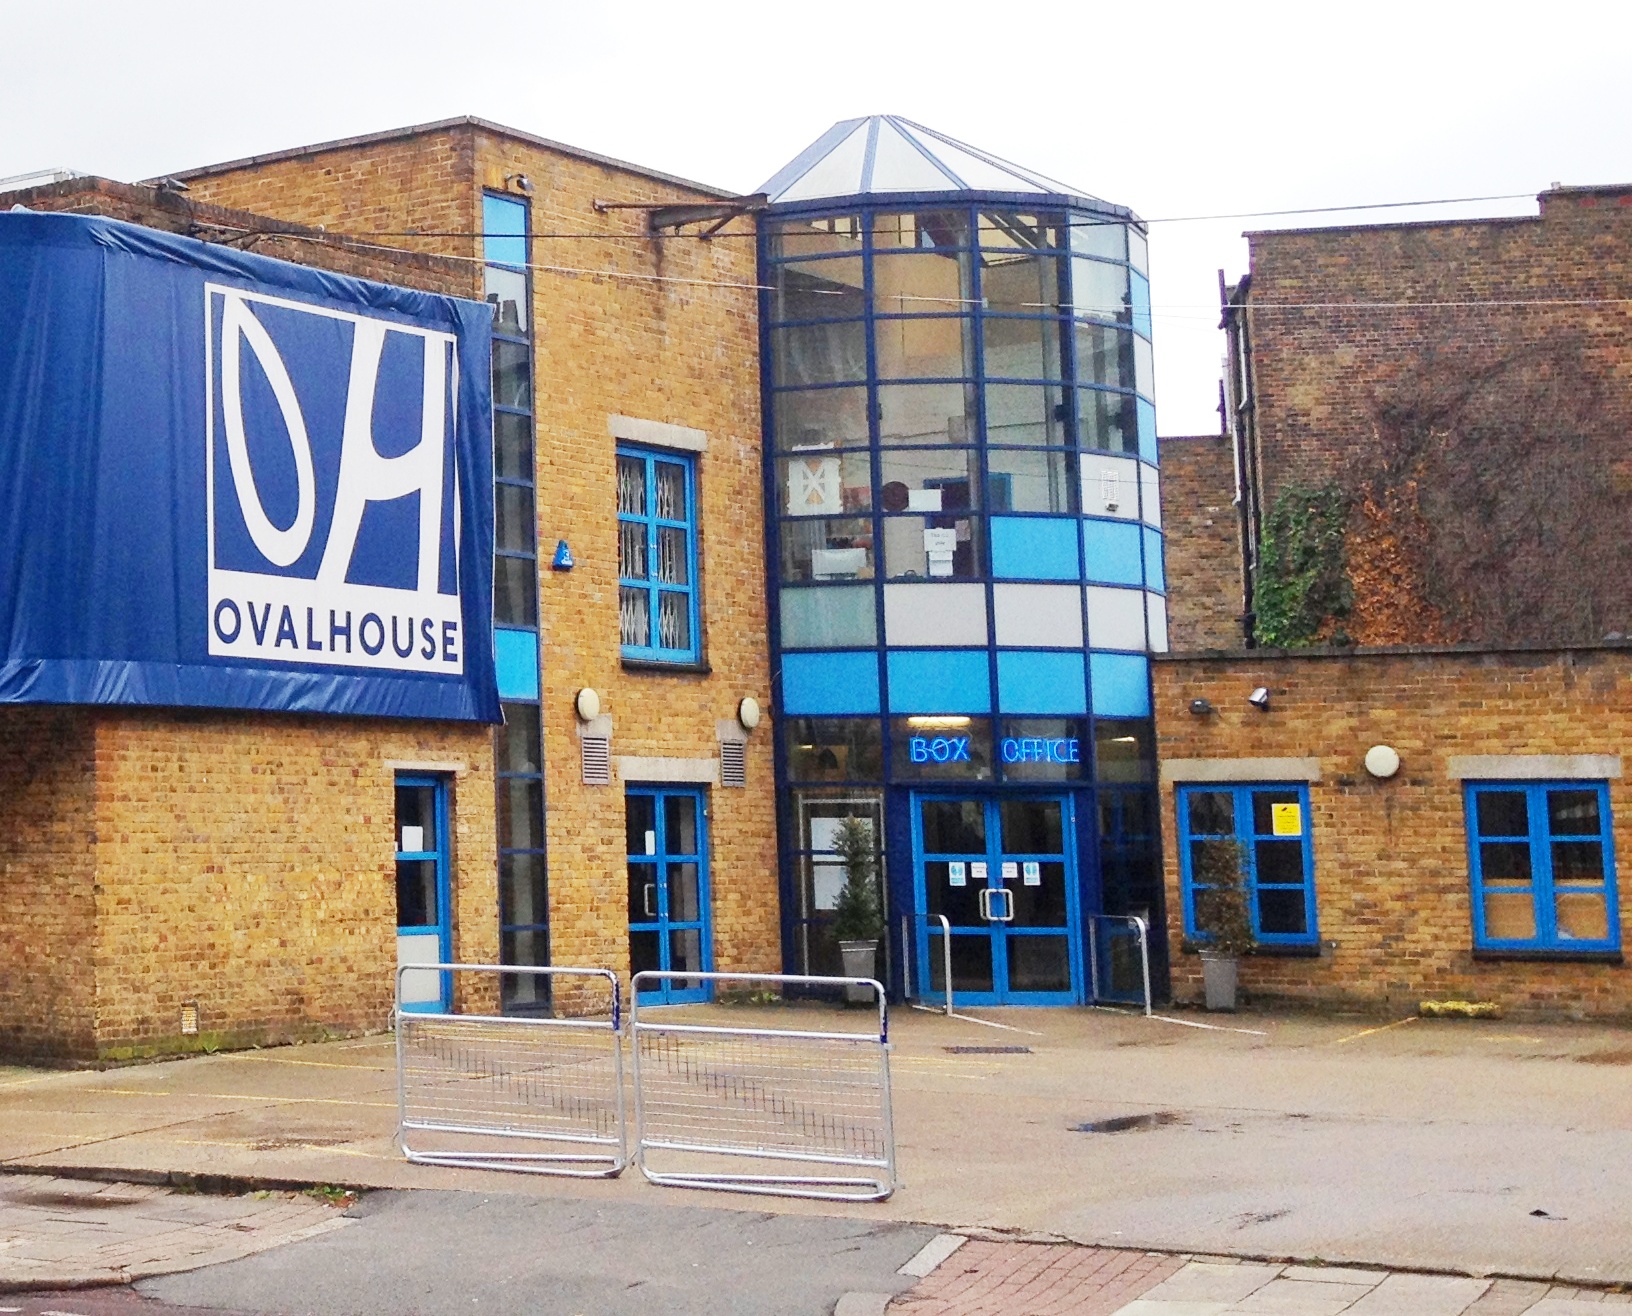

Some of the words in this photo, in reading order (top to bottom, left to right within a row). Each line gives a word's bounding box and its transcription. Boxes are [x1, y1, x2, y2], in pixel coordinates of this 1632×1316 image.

[214, 598, 458, 662] OVALHOUSE
[911, 738, 970, 763] BOX
[1002, 738, 1080, 763] OFFICE
